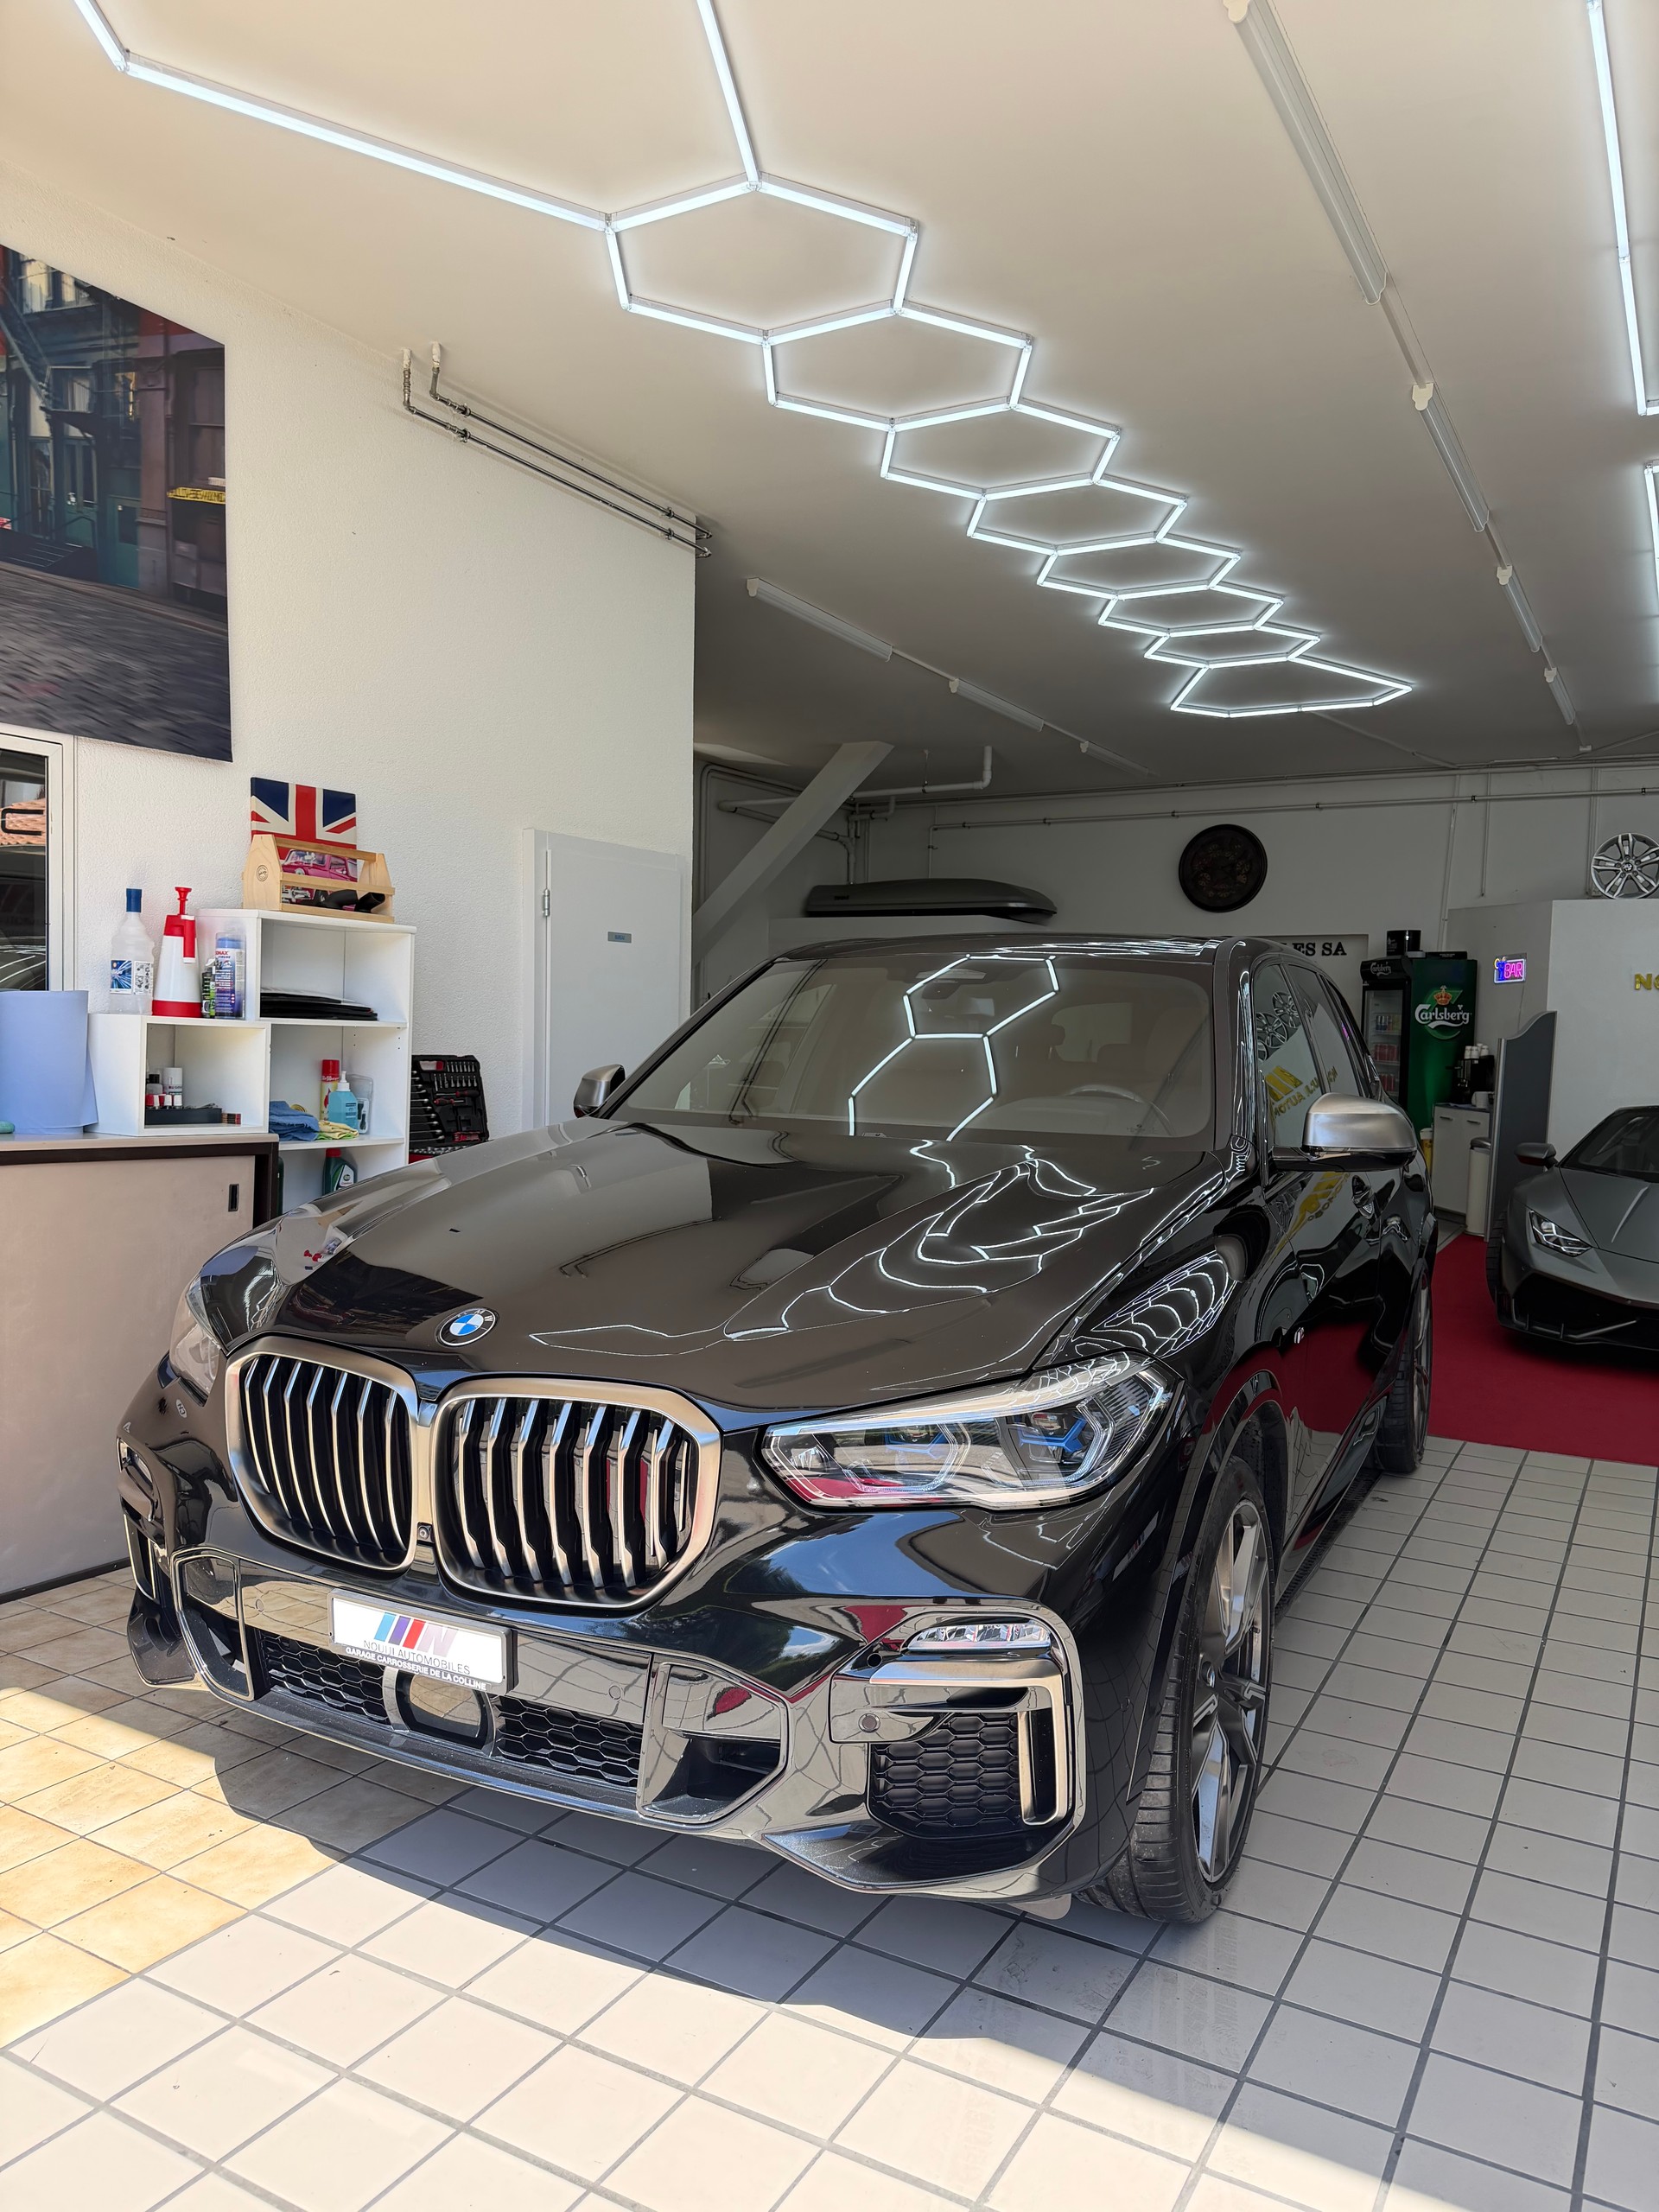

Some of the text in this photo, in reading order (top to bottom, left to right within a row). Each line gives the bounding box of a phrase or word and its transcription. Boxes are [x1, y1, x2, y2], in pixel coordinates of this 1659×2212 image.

[1322, 941, 1347, 957] SA
[1503, 963, 1523, 979] BAR
[1414, 1004, 1470, 1026] Carlsberg
[346, 1647, 487, 1691] GARAGE CARROSSERIE DE LA COLLINE
[397, 1649, 471, 1675] AUTOMOBILES
